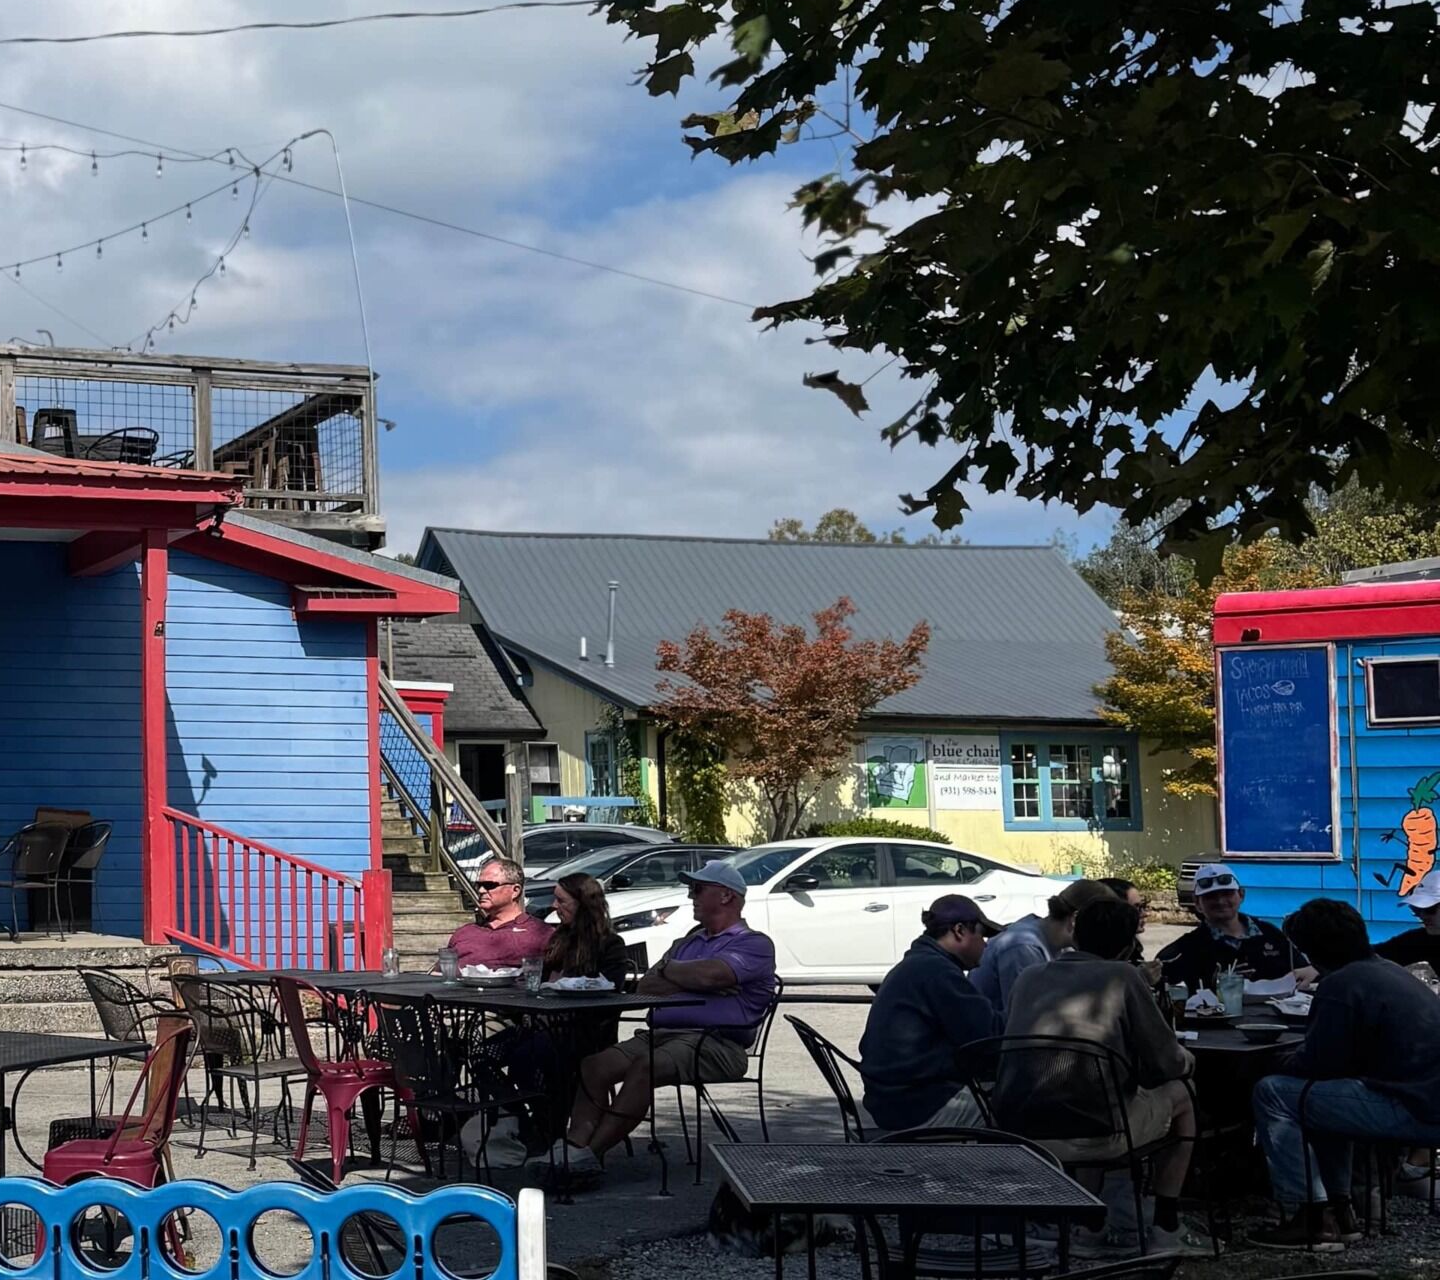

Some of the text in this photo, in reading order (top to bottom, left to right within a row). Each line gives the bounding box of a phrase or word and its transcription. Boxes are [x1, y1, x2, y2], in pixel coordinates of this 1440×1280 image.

[933, 744, 1000, 758] blue chair
[940, 786, 960, 796] (931)
